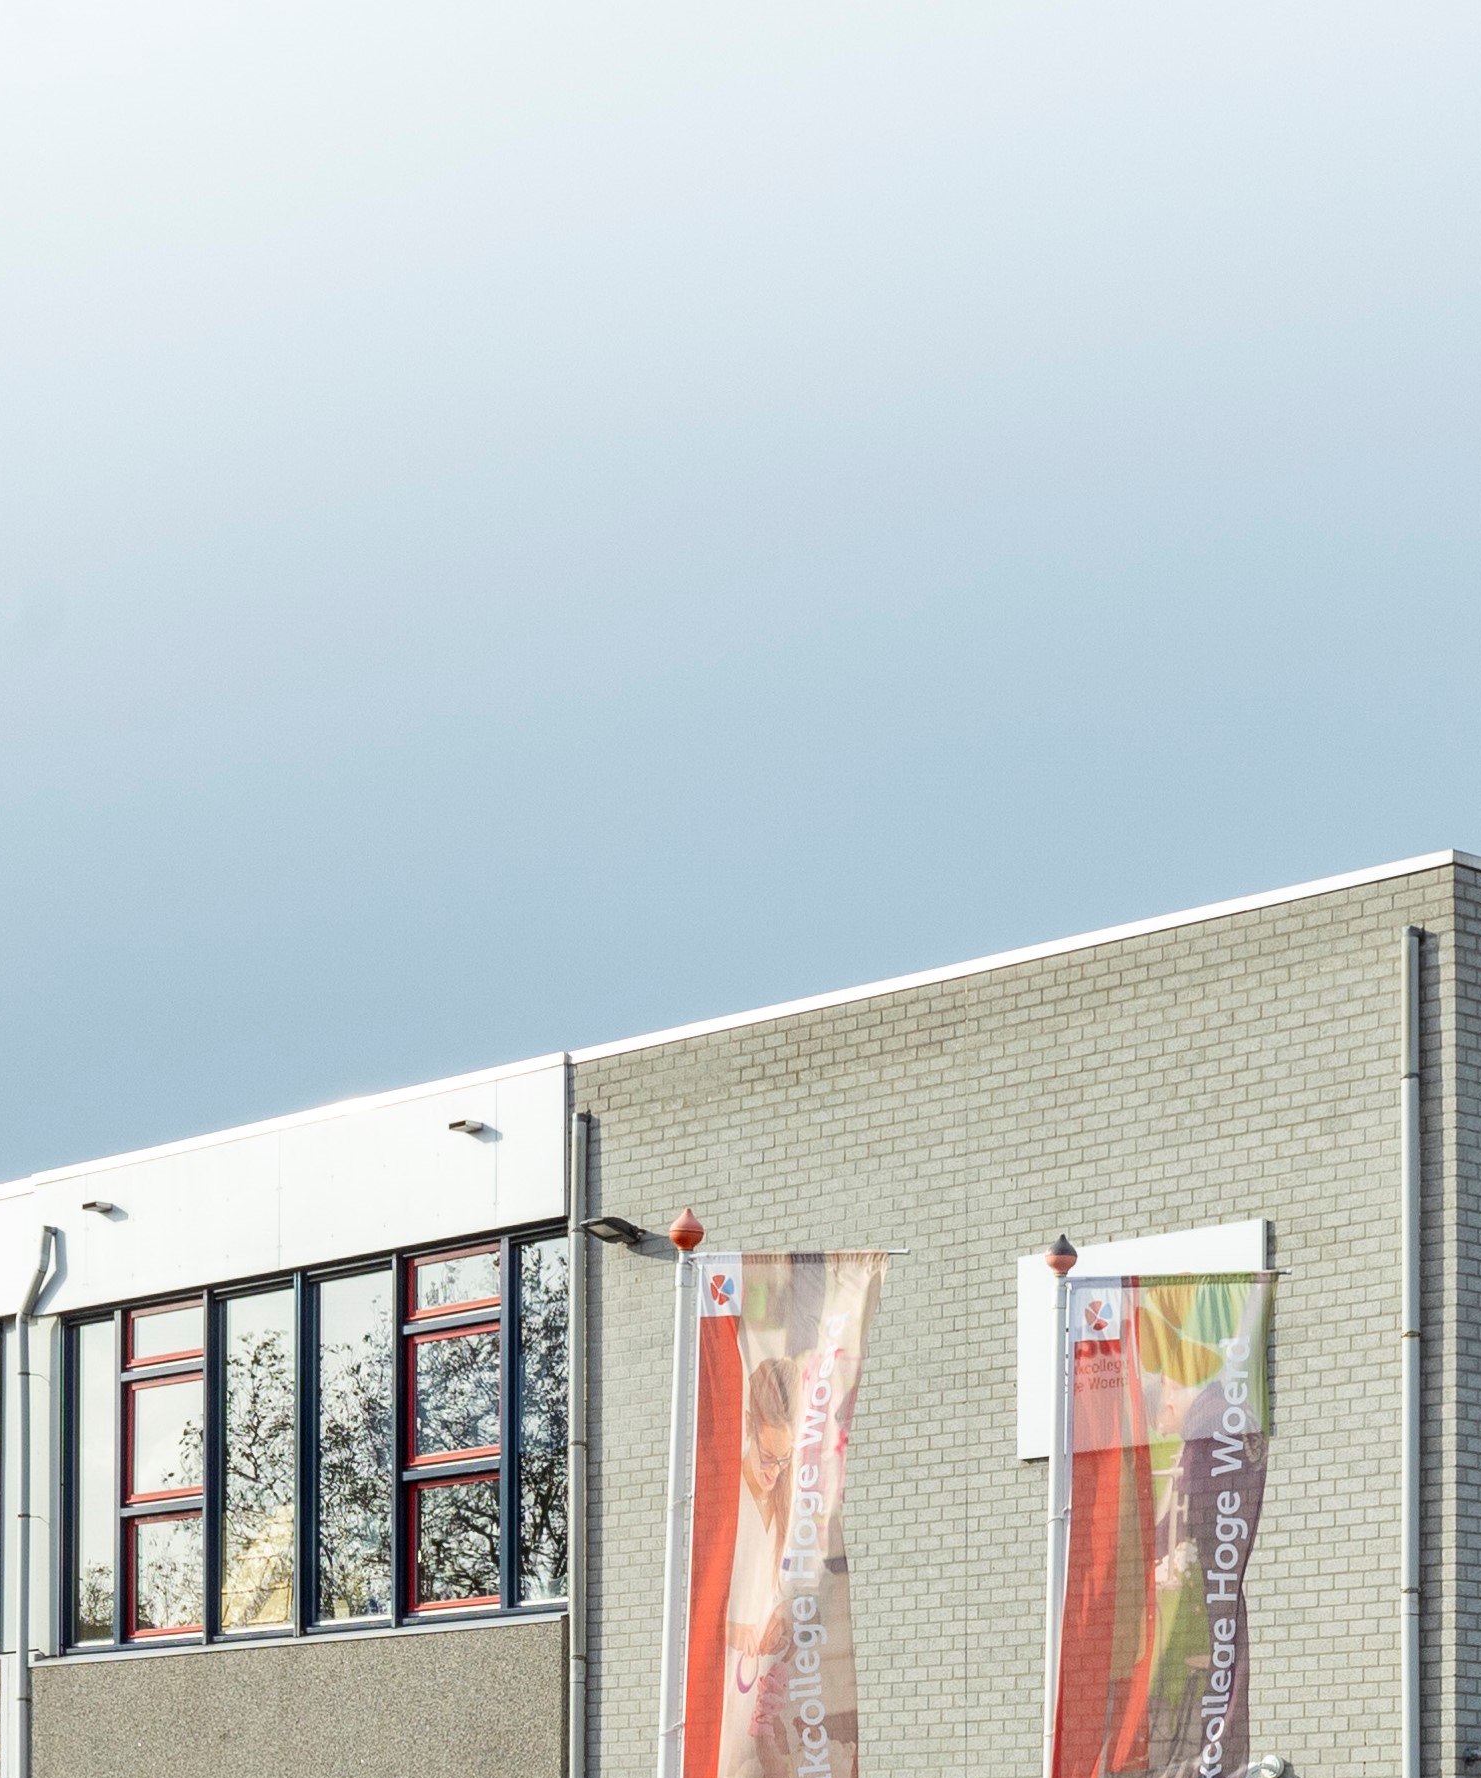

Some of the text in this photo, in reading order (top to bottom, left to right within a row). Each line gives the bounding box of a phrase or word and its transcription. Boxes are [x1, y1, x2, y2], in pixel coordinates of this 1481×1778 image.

[1211, 1336, 1251, 1477] Woerd
[785, 1463, 823, 1582] Hoge
[1206, 1490, 1248, 1604] Hoge
